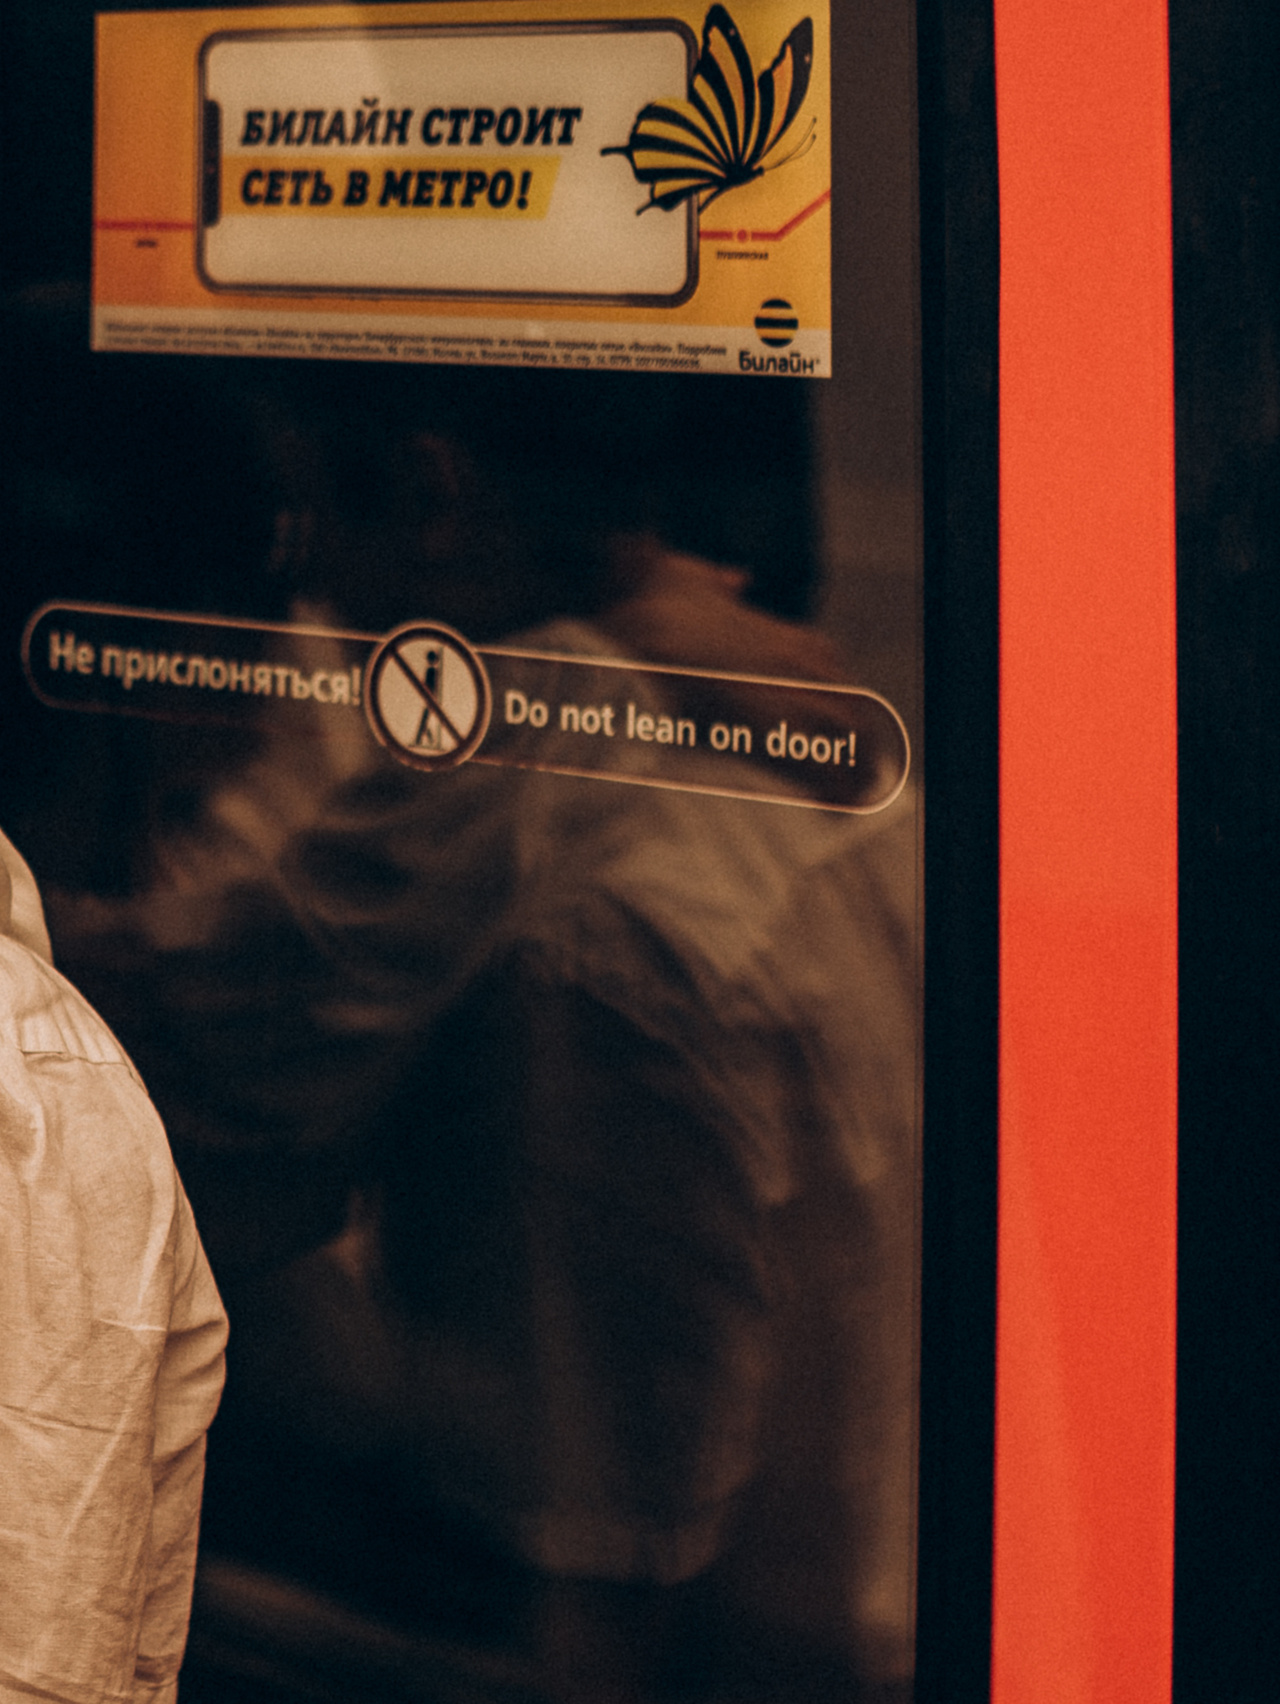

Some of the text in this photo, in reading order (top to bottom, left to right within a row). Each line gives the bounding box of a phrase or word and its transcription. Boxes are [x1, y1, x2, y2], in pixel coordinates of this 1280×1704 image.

[241, 98, 583, 146] БИЛАЙН СТРОИТ
[240, 168, 533, 210] СЕТЬ В МЕТРО!
[739, 350, 815, 374] Билайн
[49, 631, 362, 706] Не прислоняться!
[505, 689, 856, 767] Do not lean on door!
